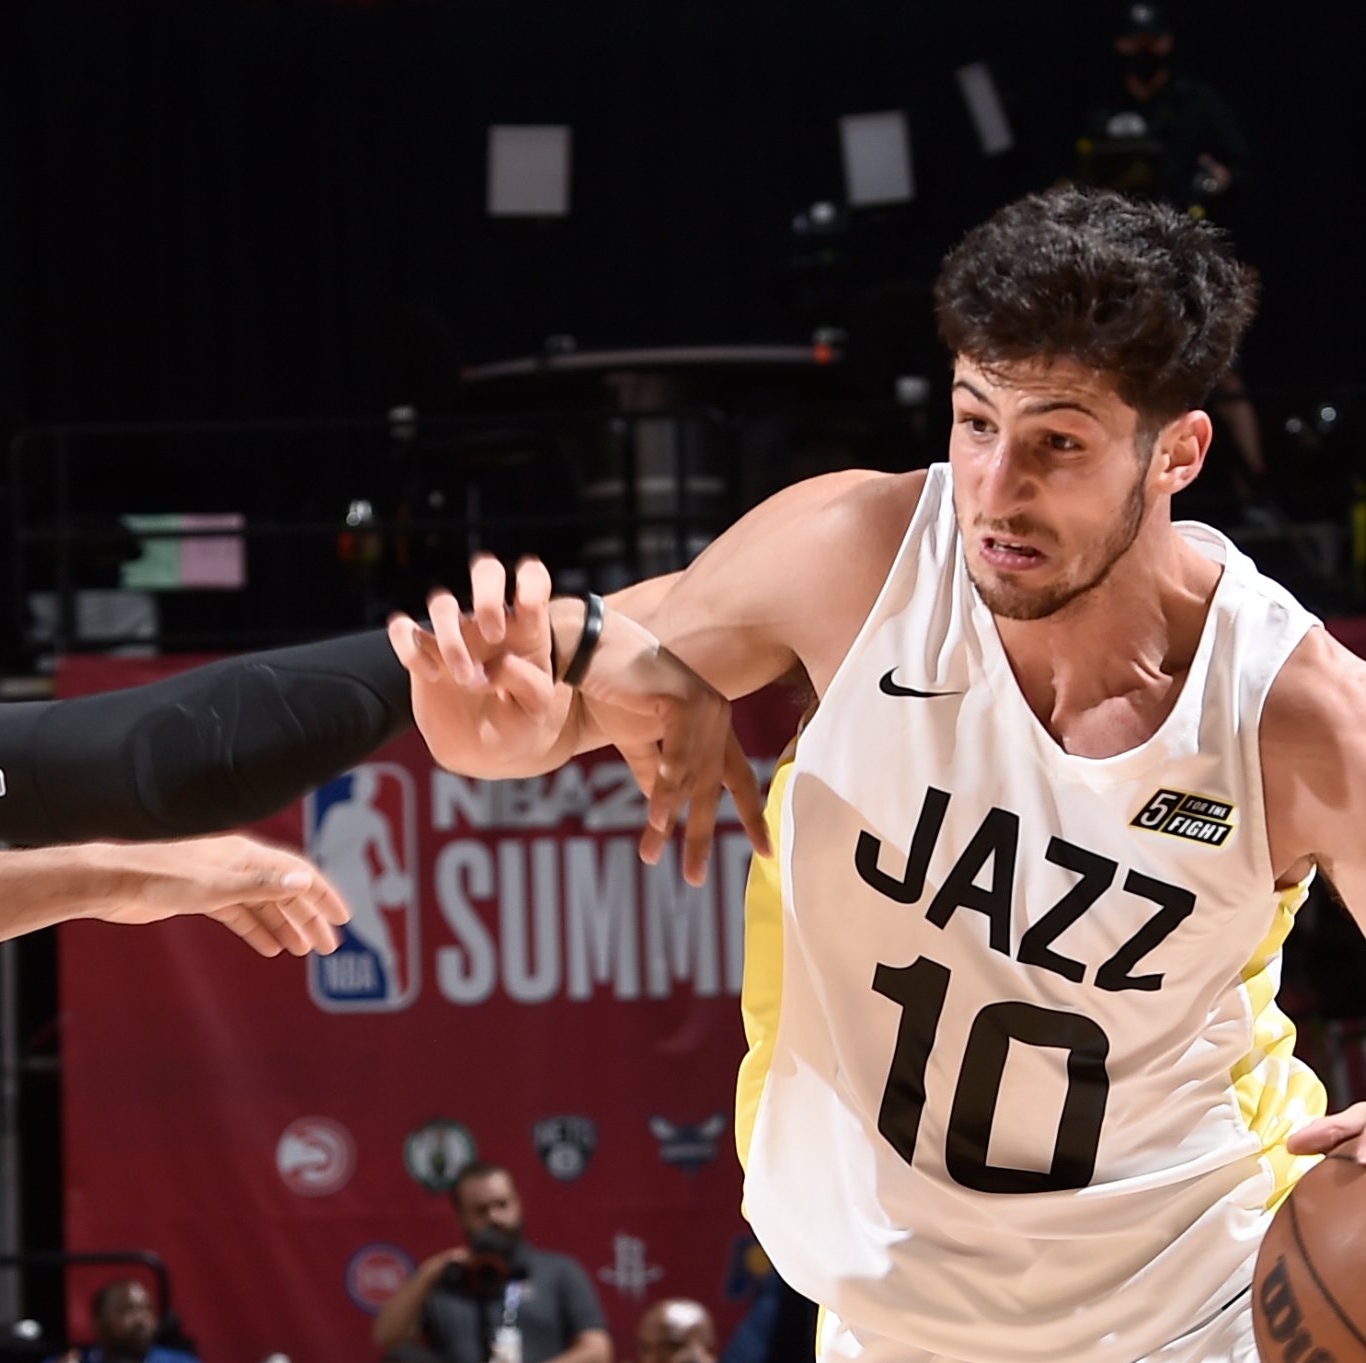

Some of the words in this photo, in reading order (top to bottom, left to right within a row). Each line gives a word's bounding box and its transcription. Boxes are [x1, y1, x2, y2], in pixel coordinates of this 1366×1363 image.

[1139, 792, 1178, 827] 5
[1185, 799, 1209, 813] FOR
[1208, 804, 1229, 818] THE
[1166, 816, 1228, 842] FIGHT
[854, 786, 1197, 992] JAZZ
[871, 955, 1110, 1194] 10
